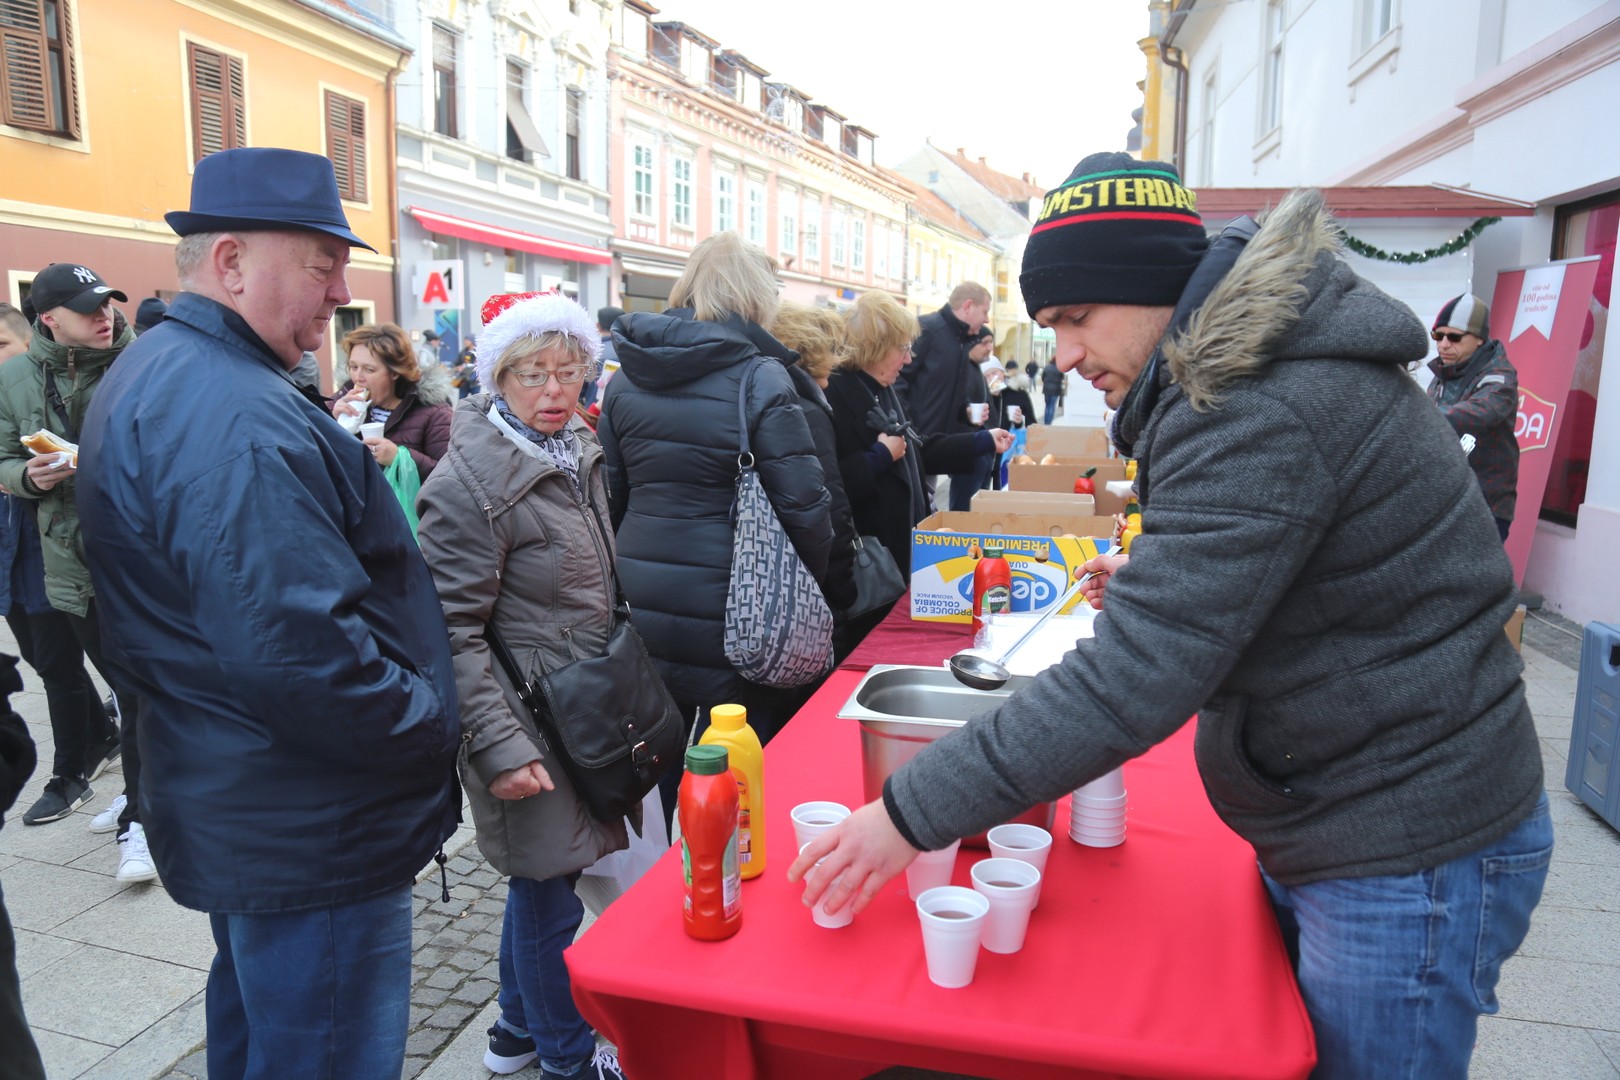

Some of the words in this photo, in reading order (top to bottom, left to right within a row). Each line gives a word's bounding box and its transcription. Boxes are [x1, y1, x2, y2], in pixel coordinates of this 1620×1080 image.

[422, 267, 453, 304] A1
[1522, 293, 1536, 303] 100
[1513, 411, 1544, 439] DA
[915, 534, 979, 547] BANANAS
[984, 538, 1050, 551] PREMIUM
[914, 598, 960, 607] COLOMBIA
[916, 605, 928, 613] OF
[930, 607, 973, 616] PRODUCE
